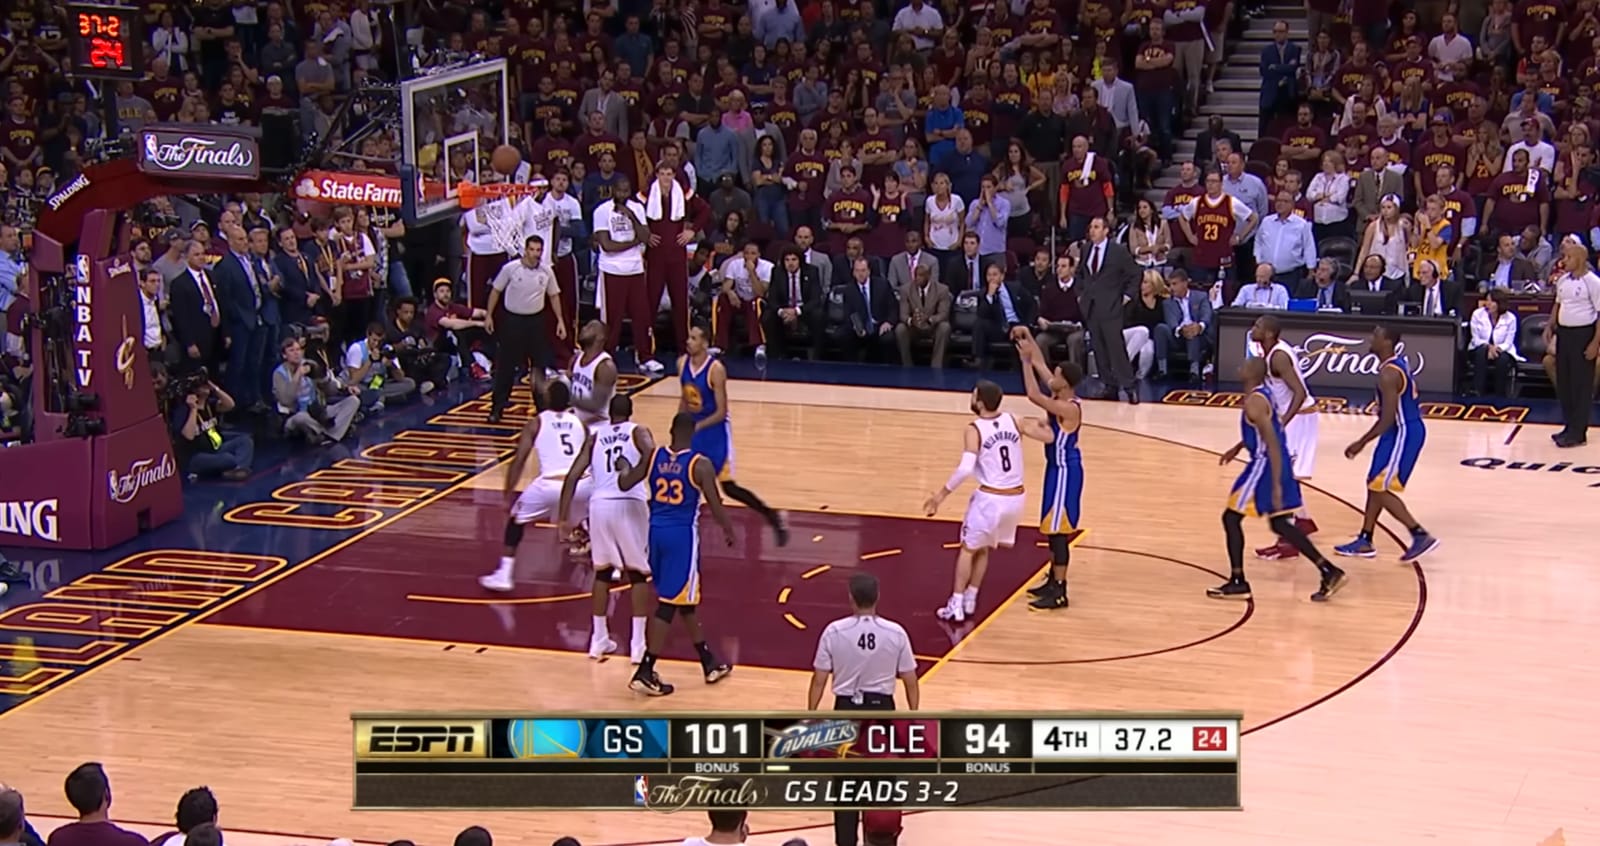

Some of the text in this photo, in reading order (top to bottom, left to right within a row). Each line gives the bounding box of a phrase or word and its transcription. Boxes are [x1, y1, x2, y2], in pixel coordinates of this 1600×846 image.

[79, 13, 120, 37] 37.2
[91, 38, 123, 68] 24
[157, 137, 245, 169] The Finals
[1203, 224, 1219, 241] 23
[77, 286, 92, 387] NBA TV
[560, 433, 574, 456] 5
[999, 445, 1012, 472] 8
[655, 477, 684, 505] 23
[857, 632, 876, 650] 48
